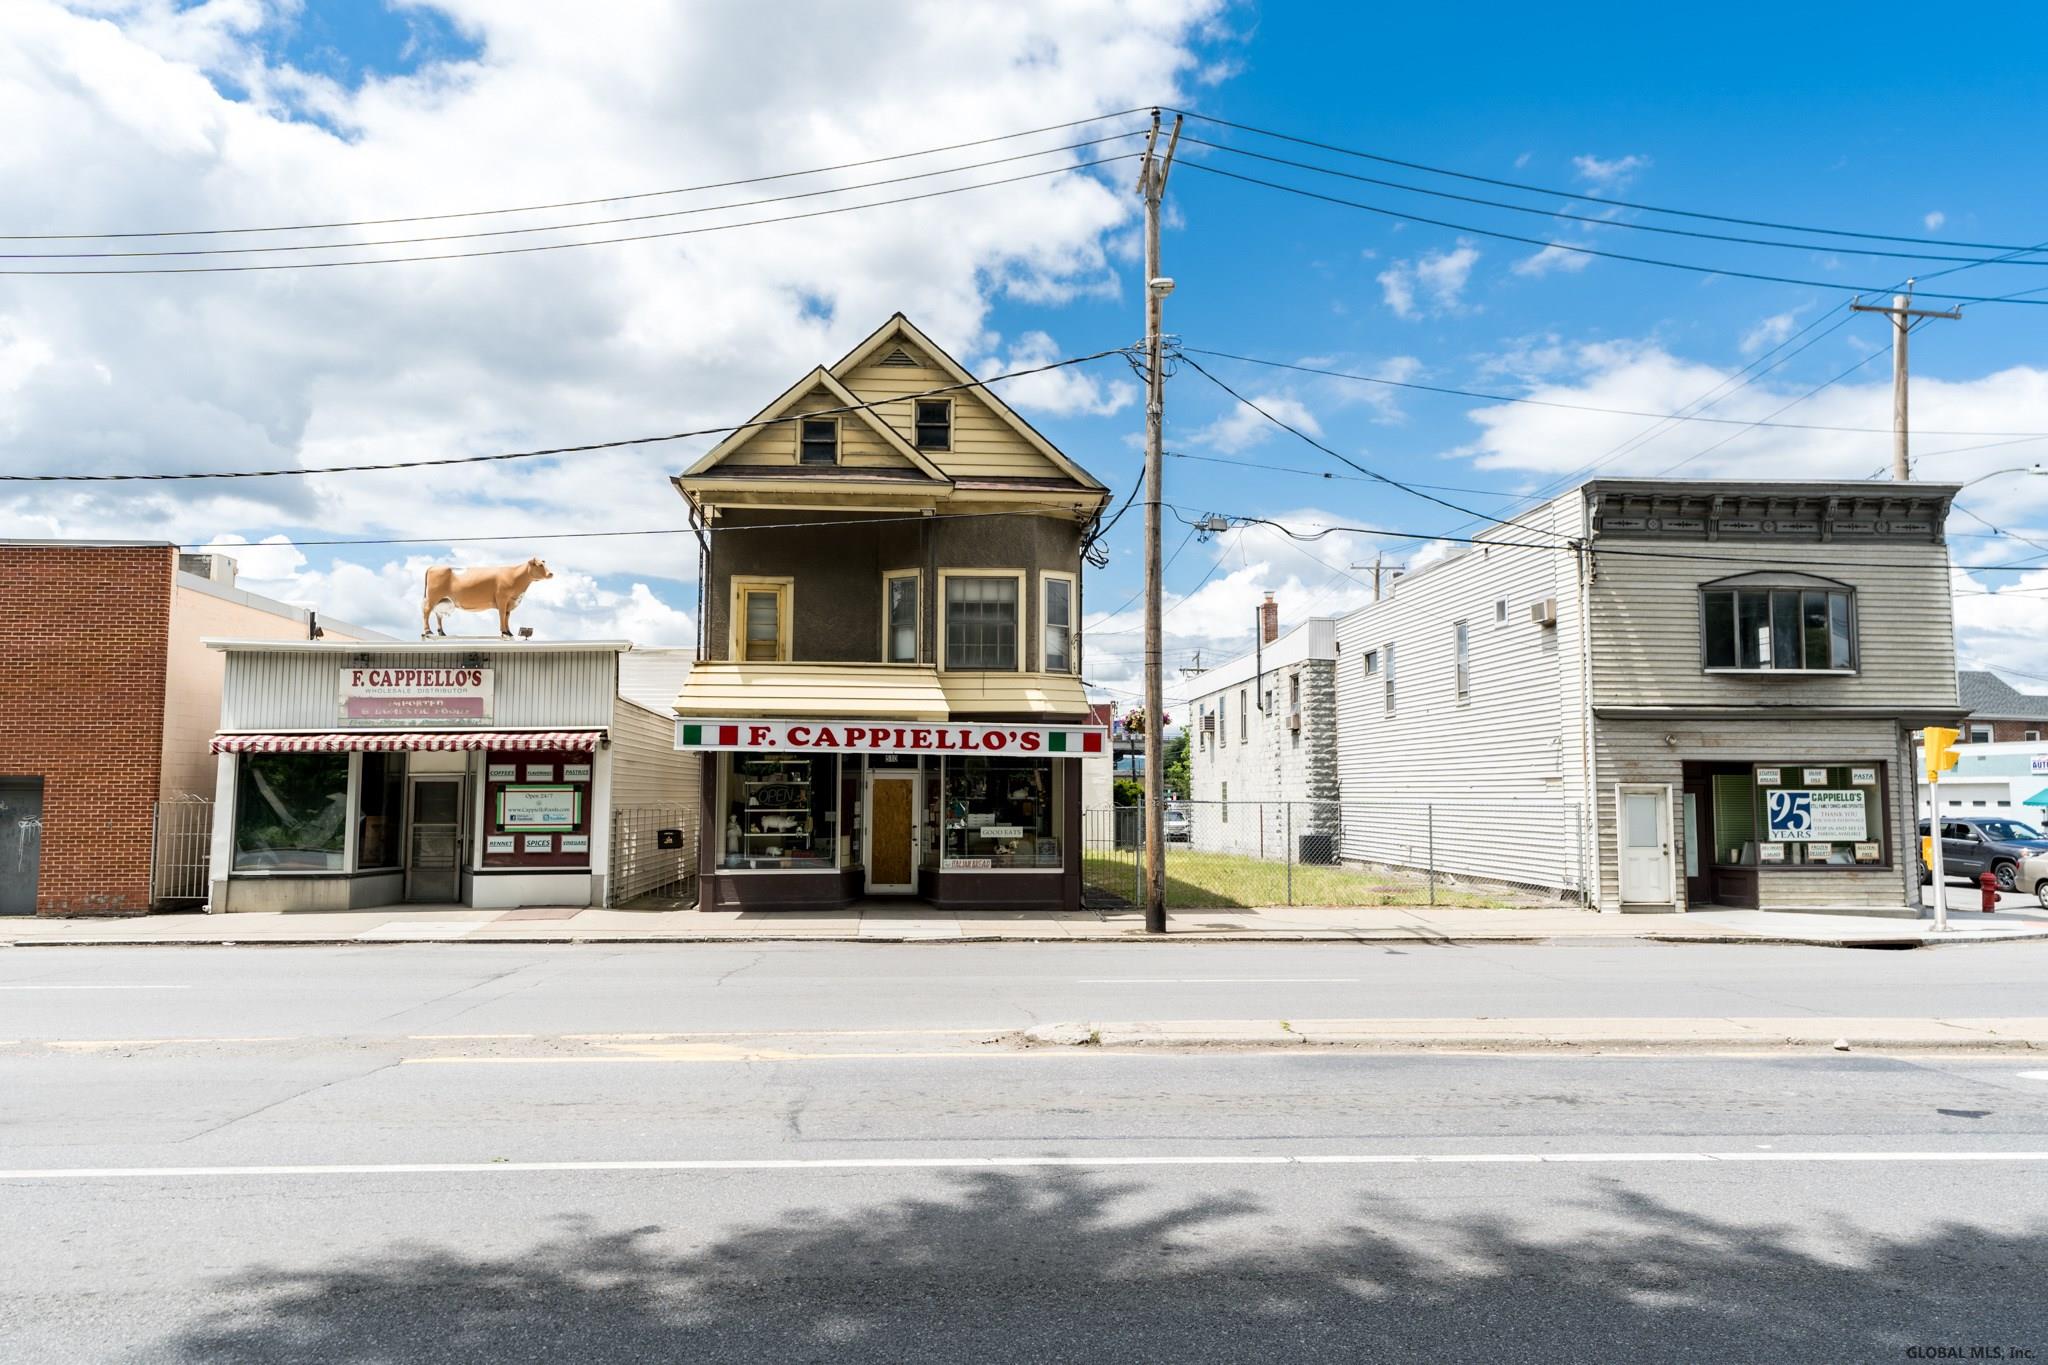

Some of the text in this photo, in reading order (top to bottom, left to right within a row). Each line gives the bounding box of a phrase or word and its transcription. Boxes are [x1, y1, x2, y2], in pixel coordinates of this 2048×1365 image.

[352, 670, 482, 687] F. CAPPIELLO'S
[748, 725, 1041, 751] F. CAPPIELLO'S
[758, 787, 794, 803] OPEN
[1811, 793, 1862, 802] CAPPIELLO'S
[1770, 792, 1811, 831] 95
[1772, 831, 1811, 839] YEARS
